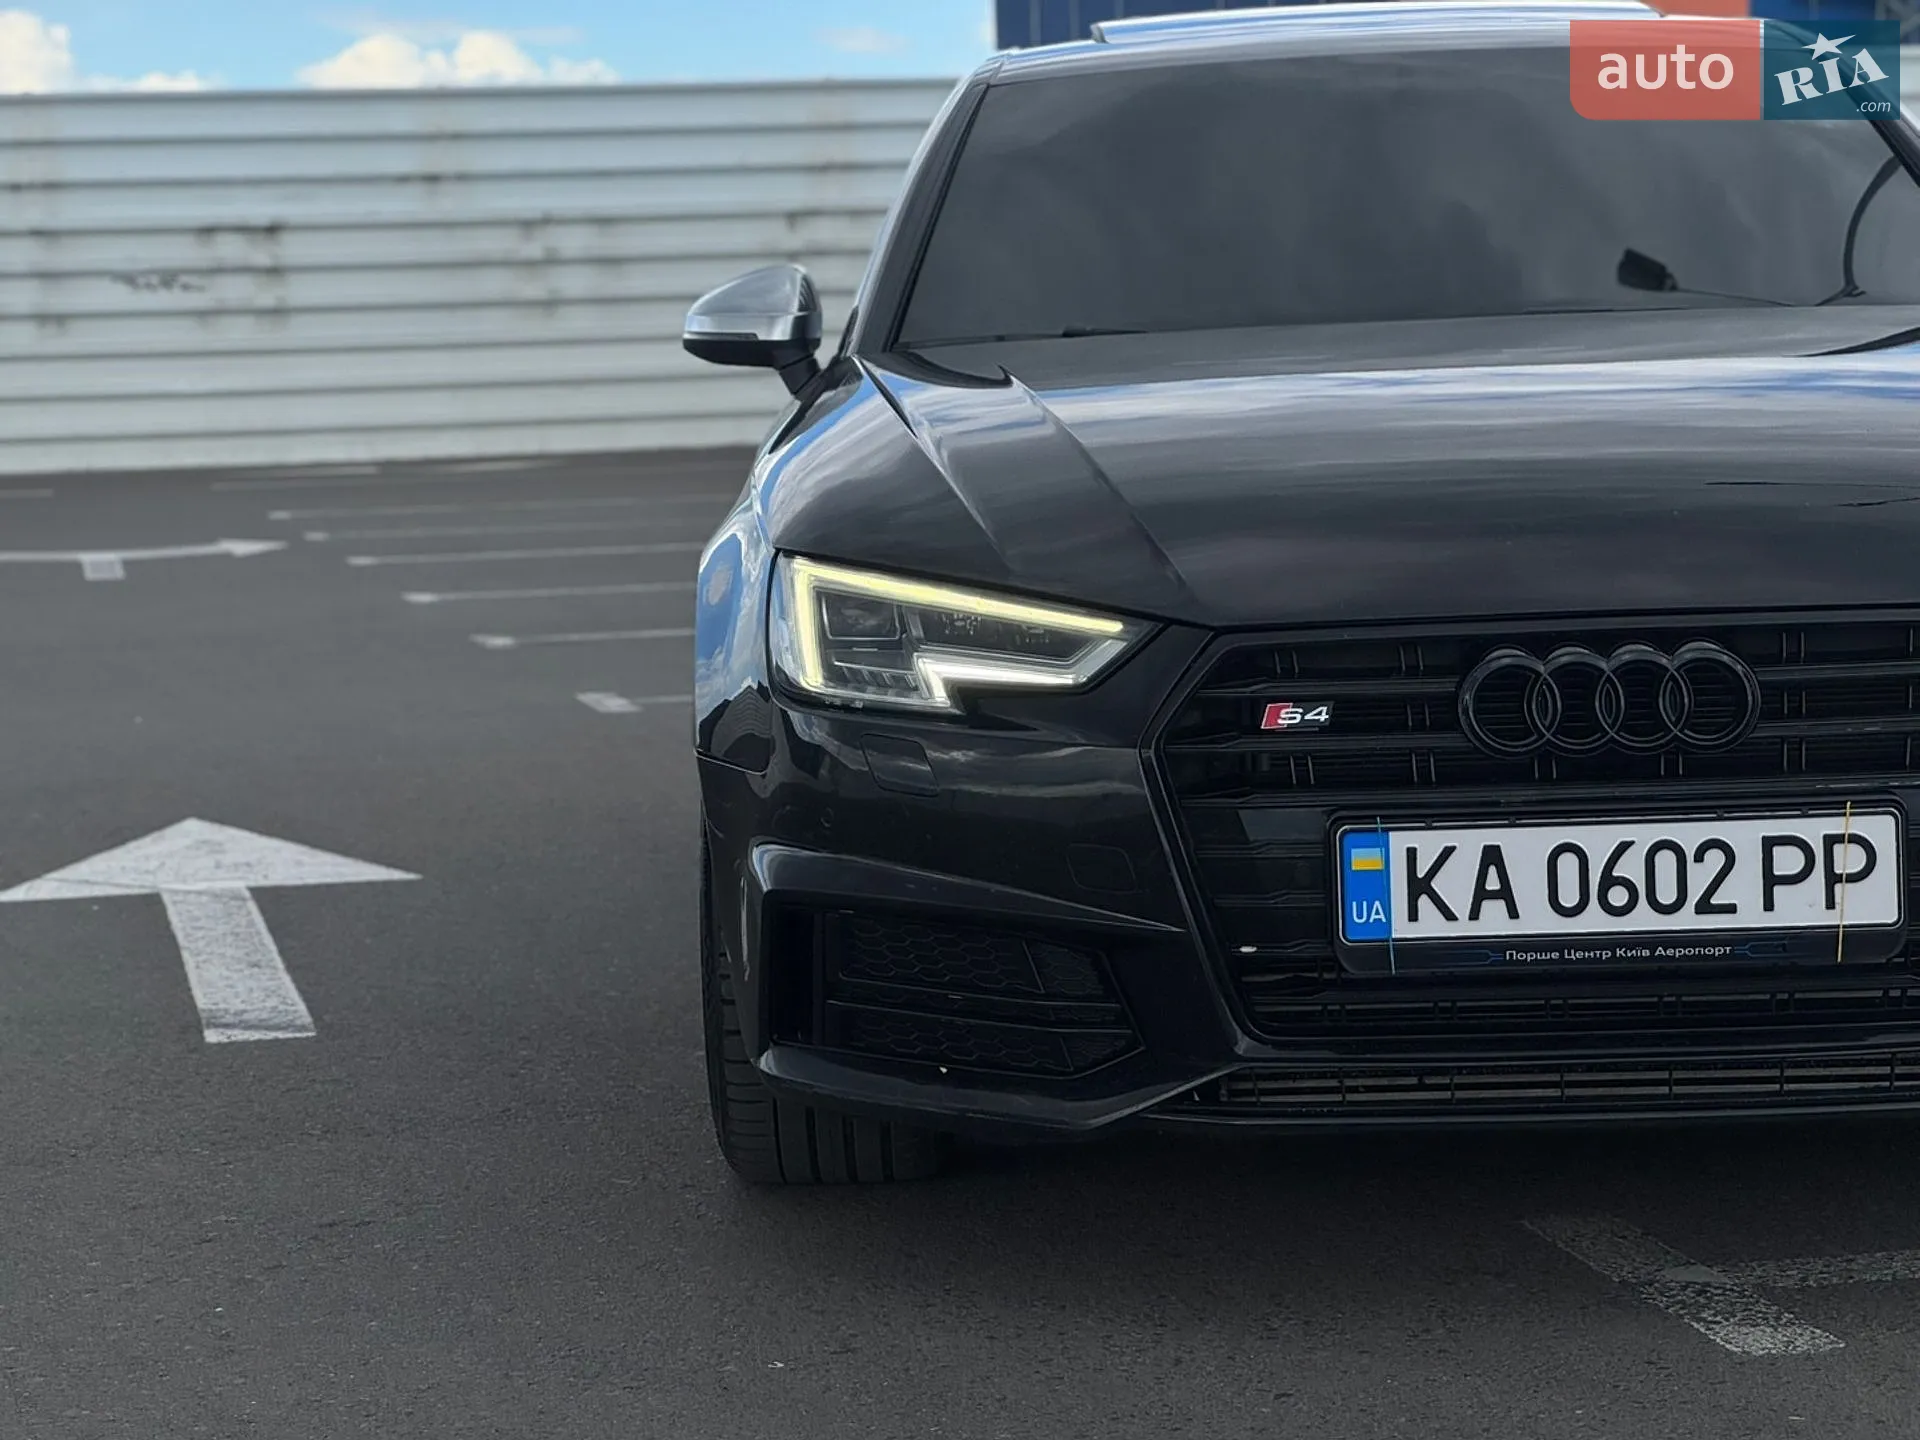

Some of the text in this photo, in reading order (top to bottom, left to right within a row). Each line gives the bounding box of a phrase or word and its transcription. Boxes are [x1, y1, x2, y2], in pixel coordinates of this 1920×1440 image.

[1277, 706, 1329, 724] S4
[1405, 831, 1878, 922] KA 0602 PP
[1351, 900, 1387, 924] UA
[1505, 945, 1733, 963] Порше Центр Київ Аеропорт
